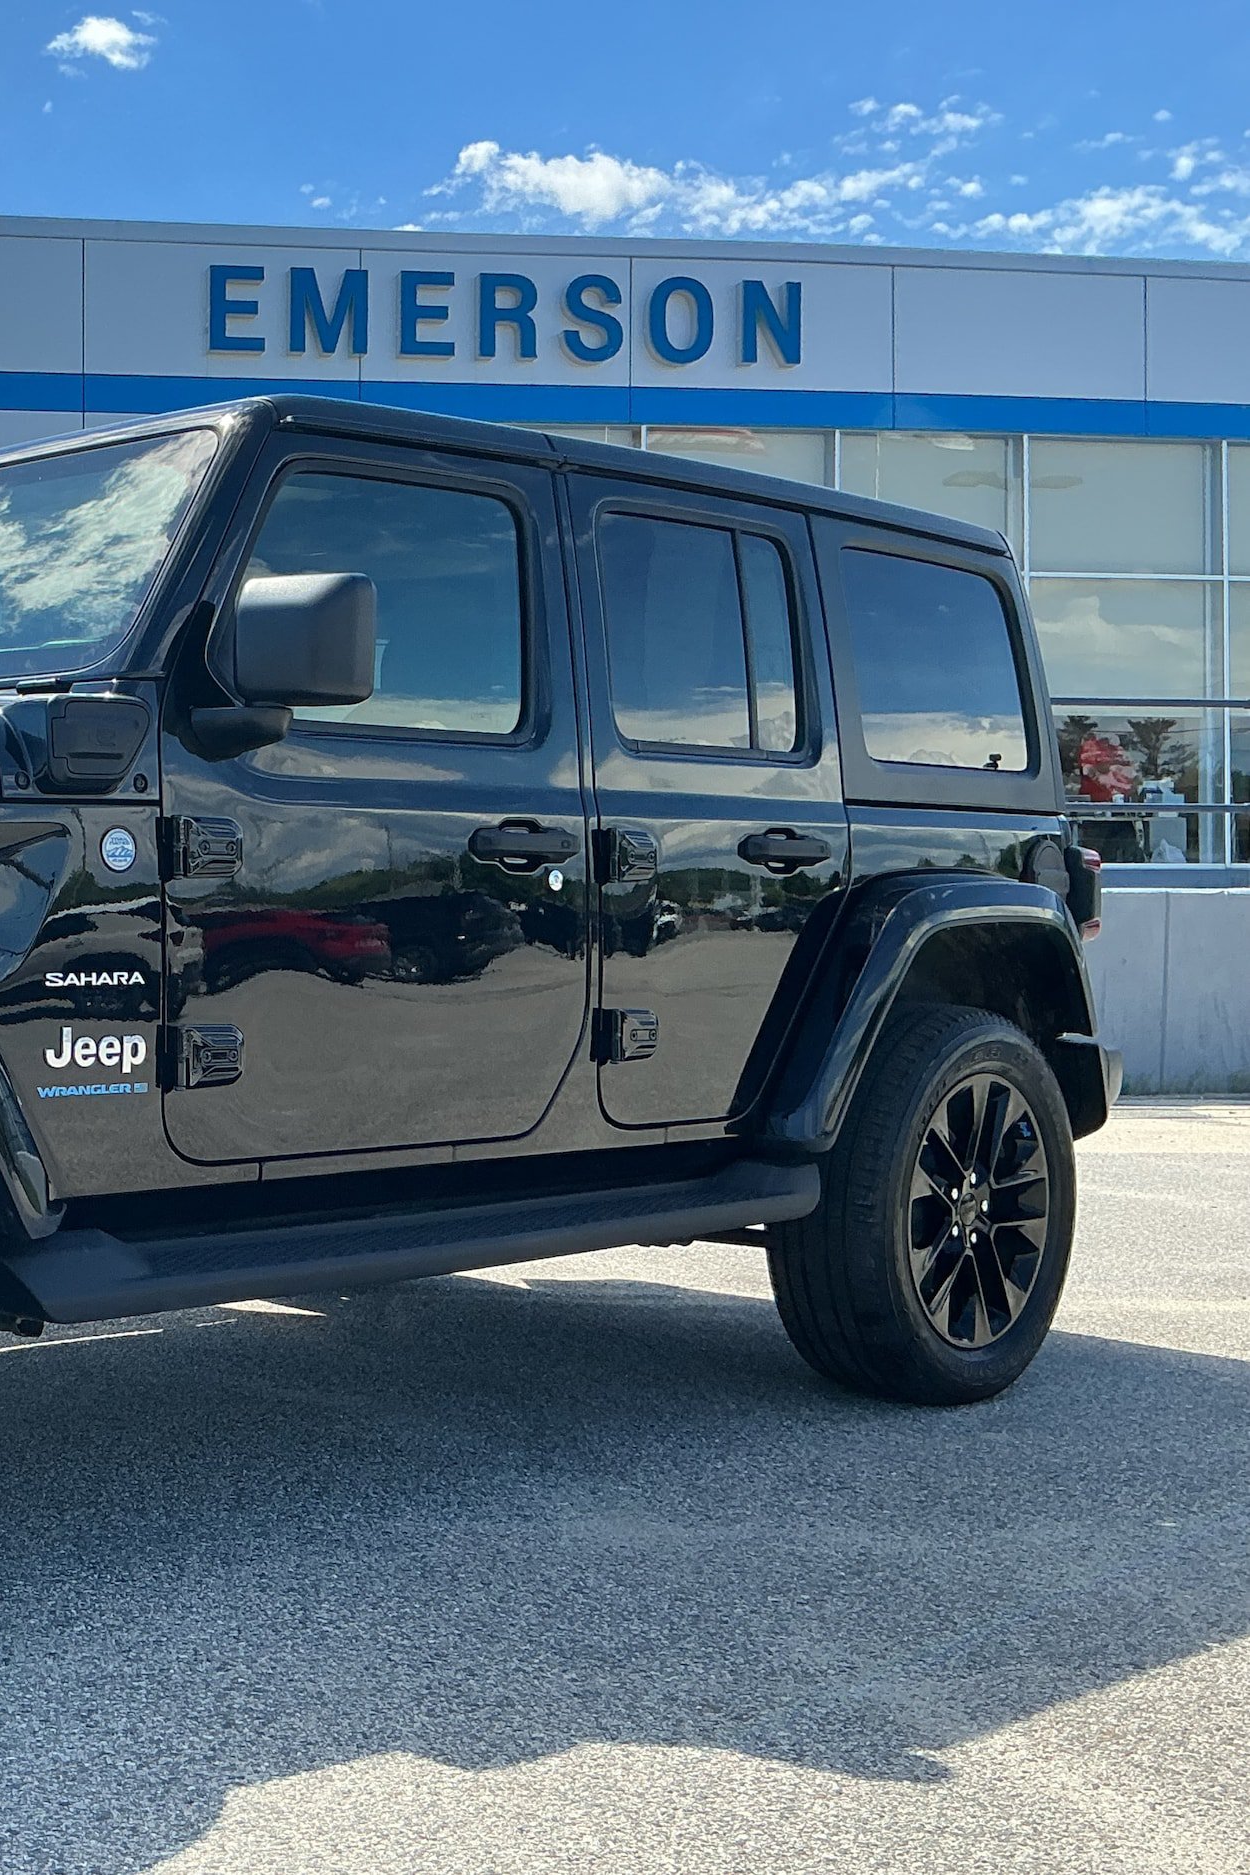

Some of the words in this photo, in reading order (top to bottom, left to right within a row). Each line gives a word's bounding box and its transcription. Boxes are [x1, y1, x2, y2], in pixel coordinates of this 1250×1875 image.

[208, 265, 802, 366] EMERSON
[44, 970, 146, 987] SAHARA
[45, 1026, 147, 1074] Jeep
[36, 1082, 132, 1100] WRANGLER
